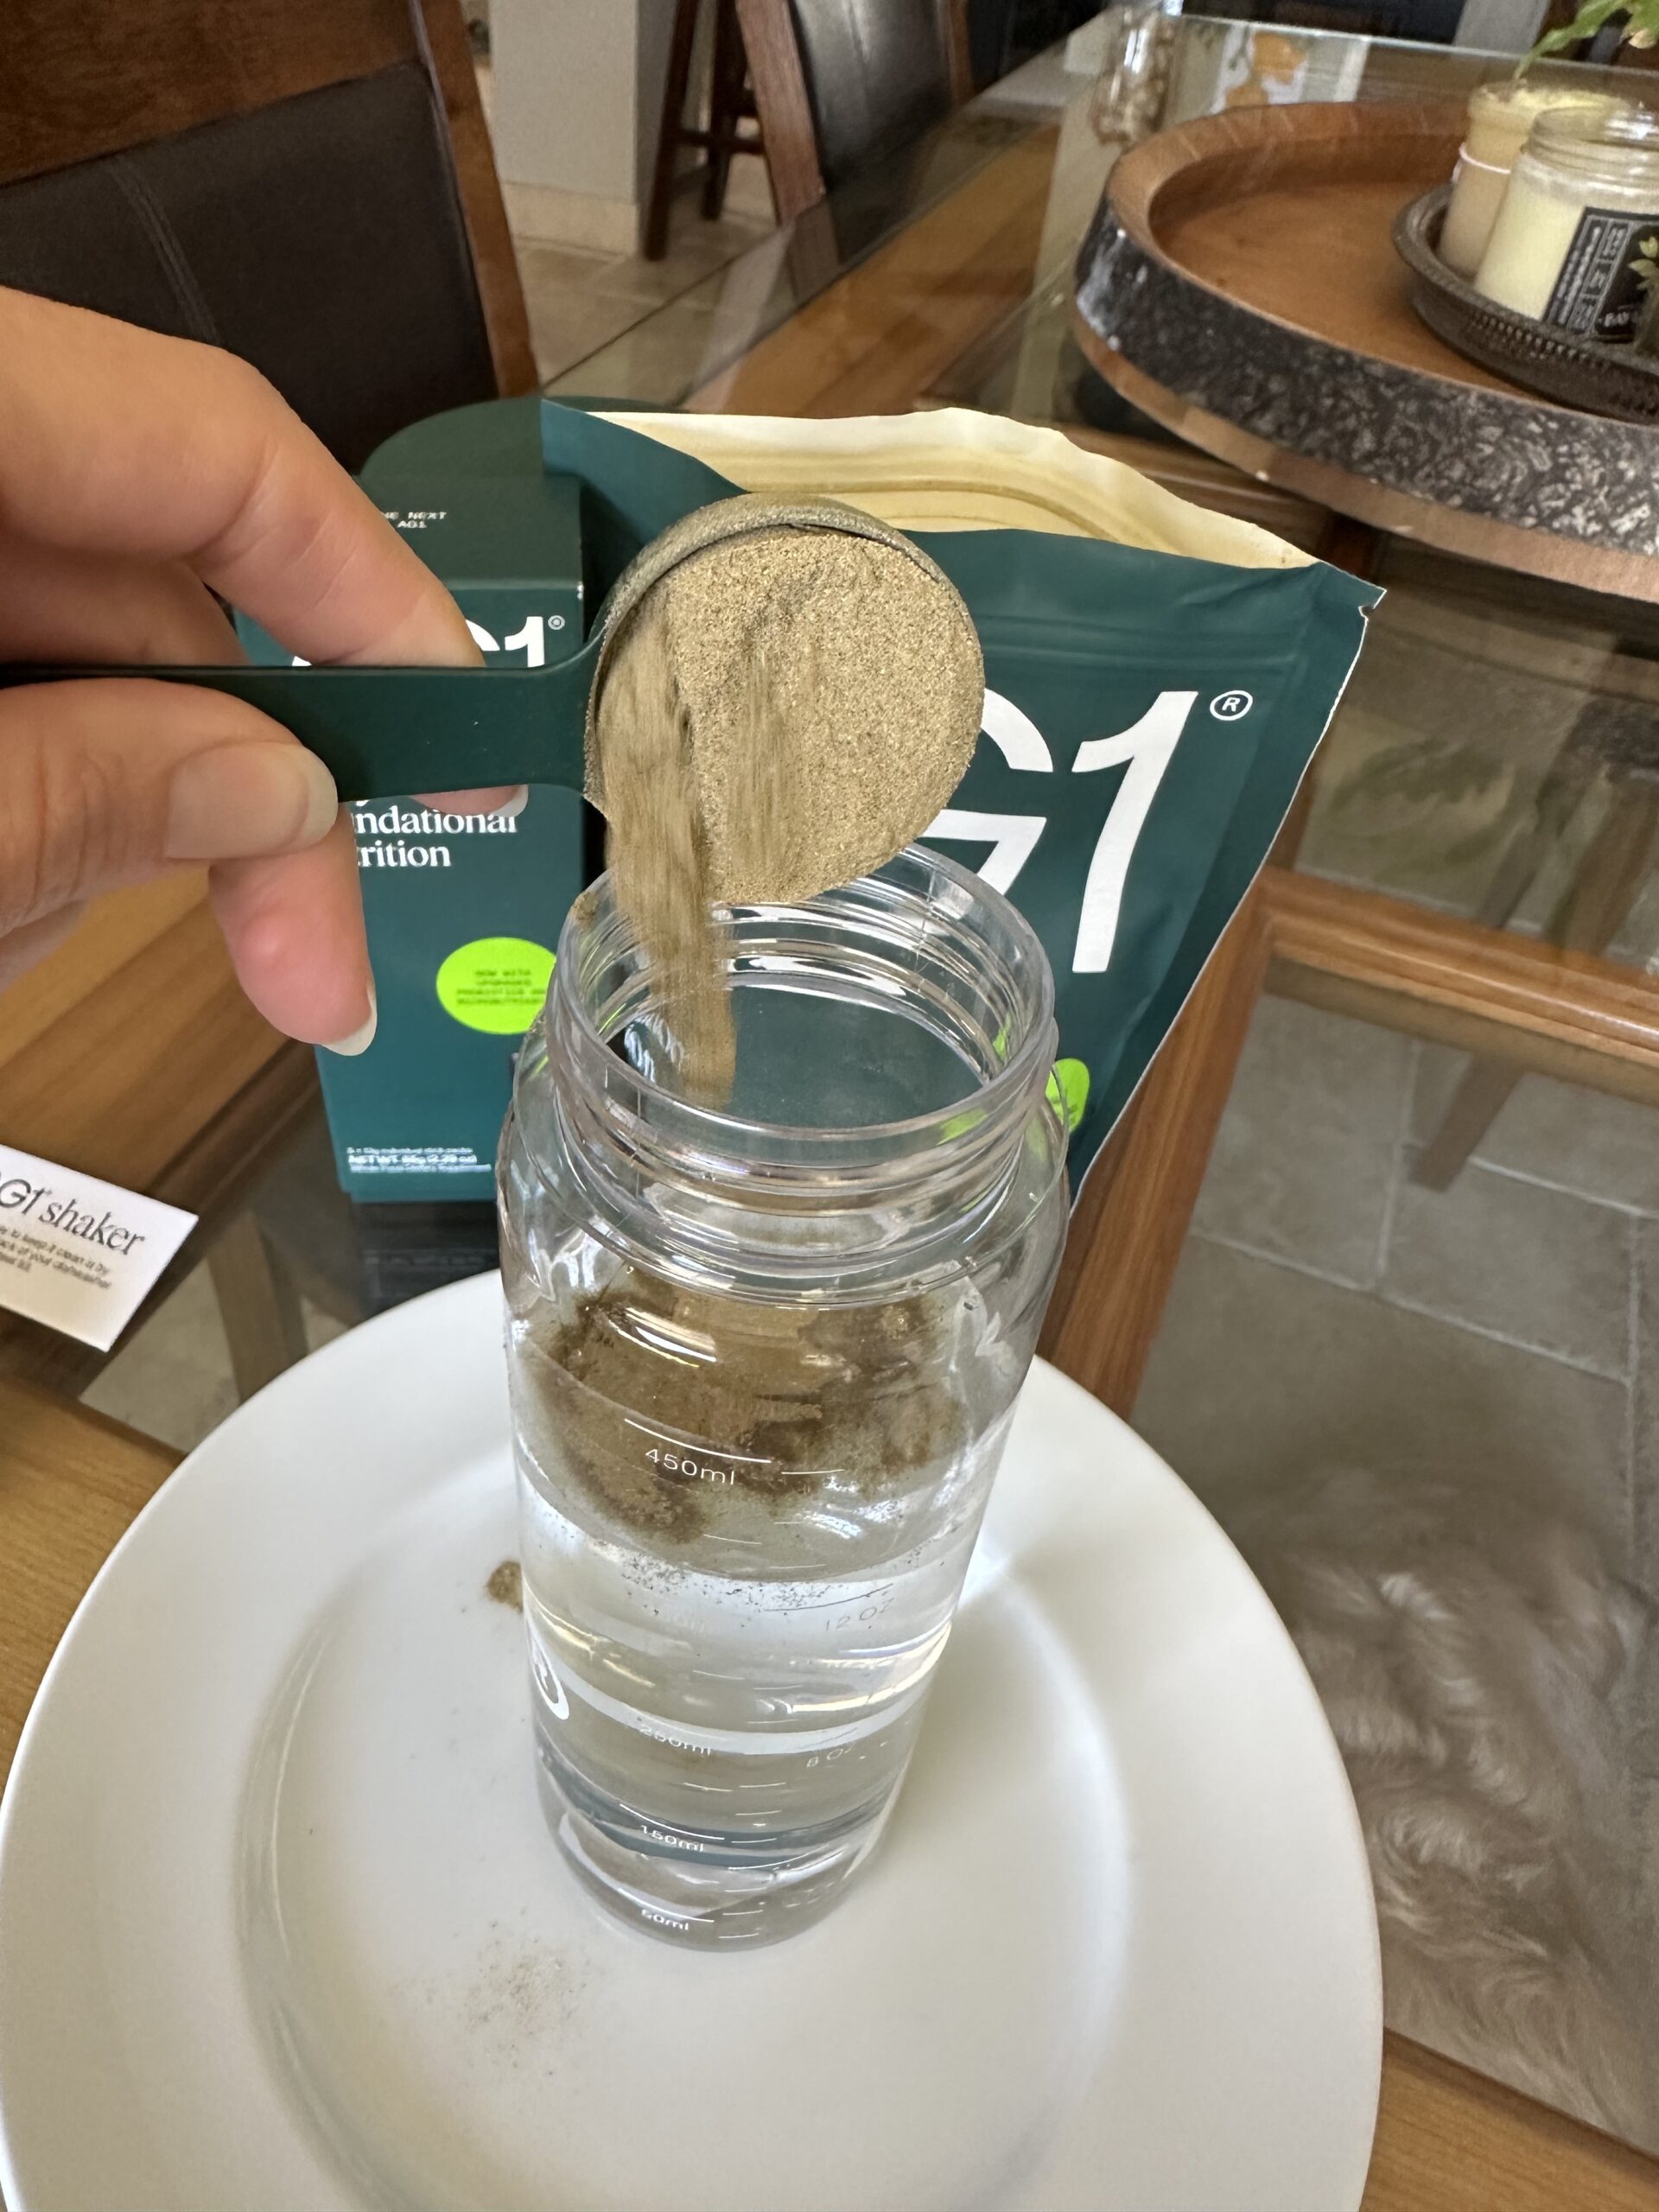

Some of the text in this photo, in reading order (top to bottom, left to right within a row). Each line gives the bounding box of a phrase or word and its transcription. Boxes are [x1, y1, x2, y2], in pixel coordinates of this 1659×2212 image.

[353, 805, 518, 834] ndational
[358, 840, 452, 868] rition
[39, 1198, 145, 1255] shaker
[645, 1448, 735, 1485] 450ml
